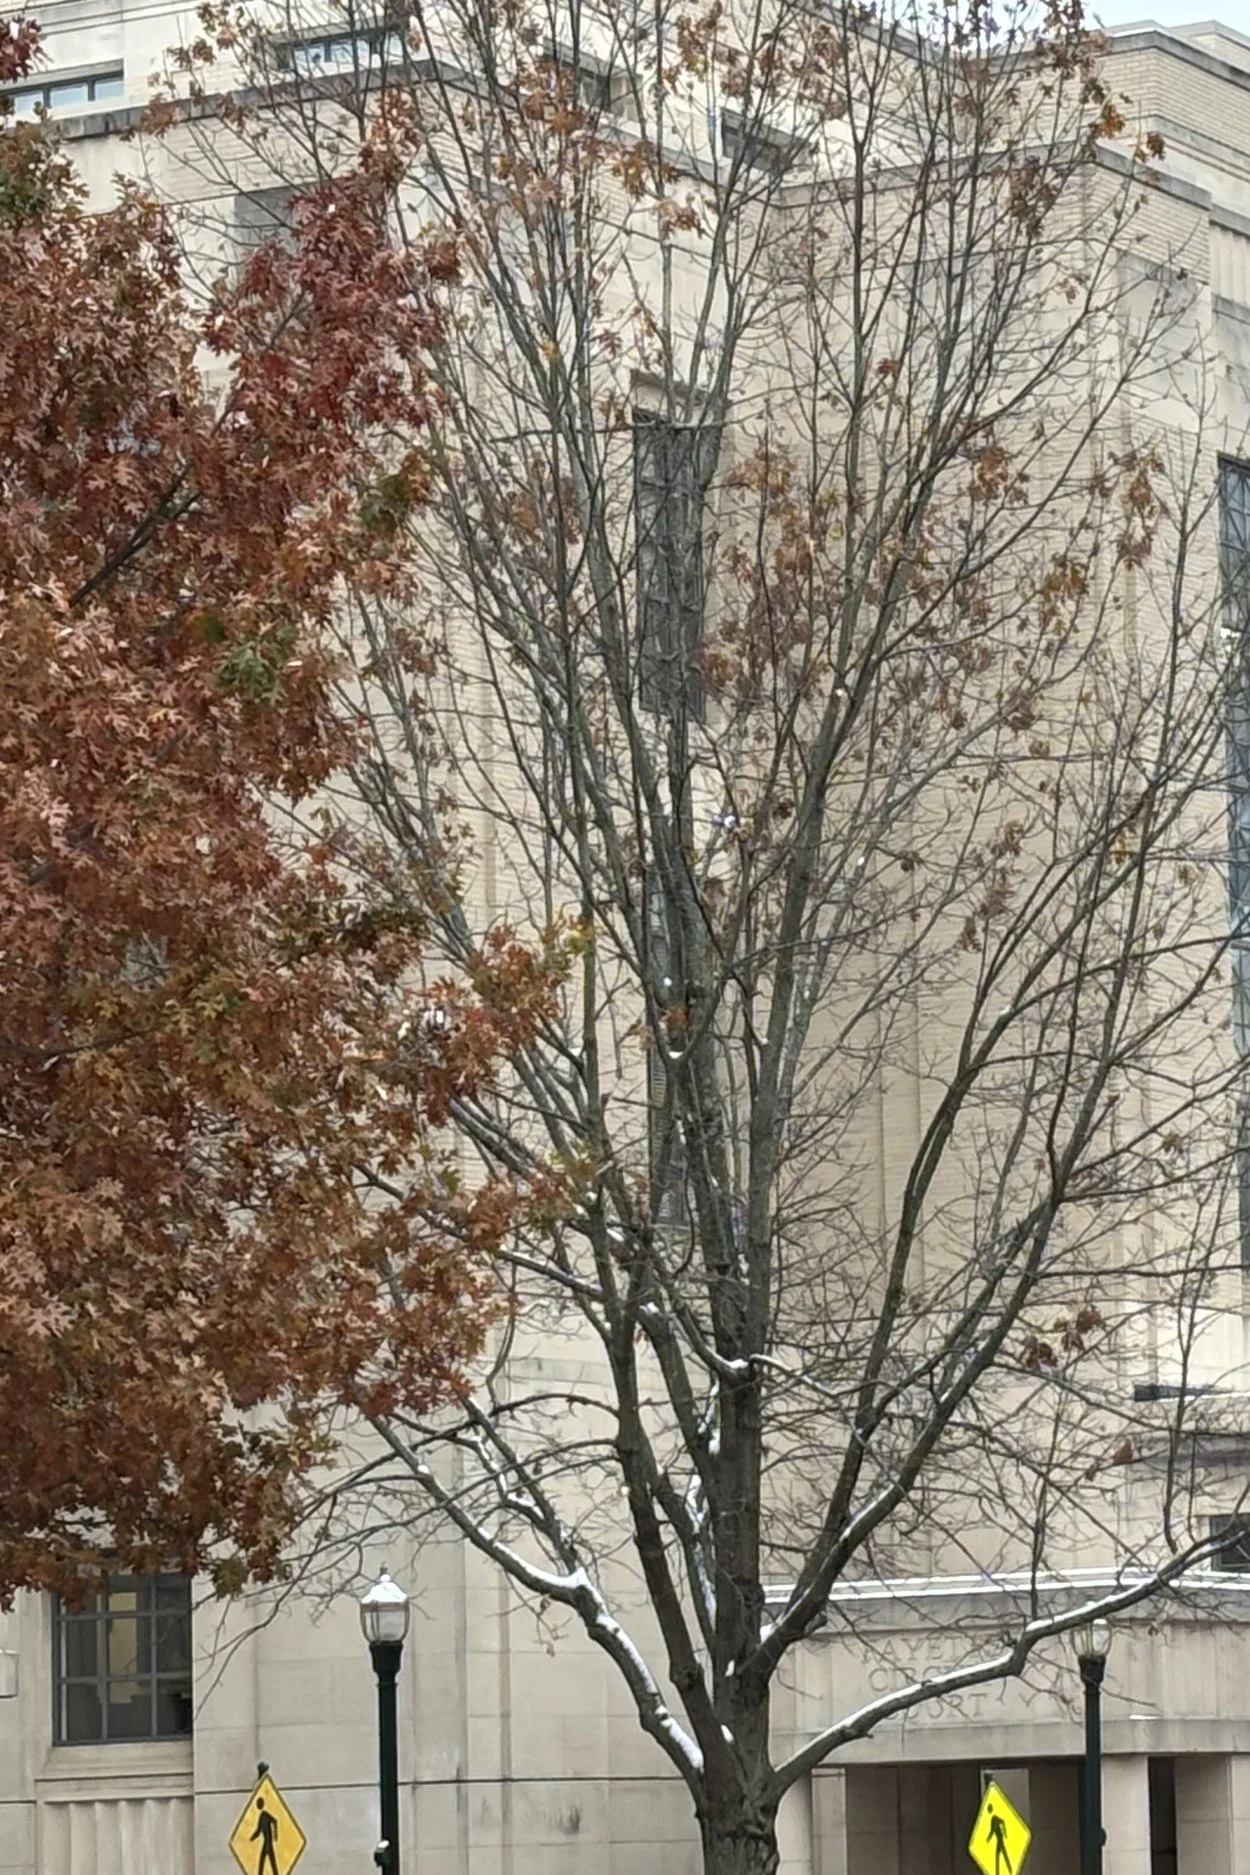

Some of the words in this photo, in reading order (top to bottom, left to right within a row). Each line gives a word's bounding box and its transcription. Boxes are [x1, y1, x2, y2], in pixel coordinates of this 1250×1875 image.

[862, 1635, 1002, 1663] FAYET
[868, 1665, 994, 1691] CIRC
[881, 1692, 987, 1719] URT
